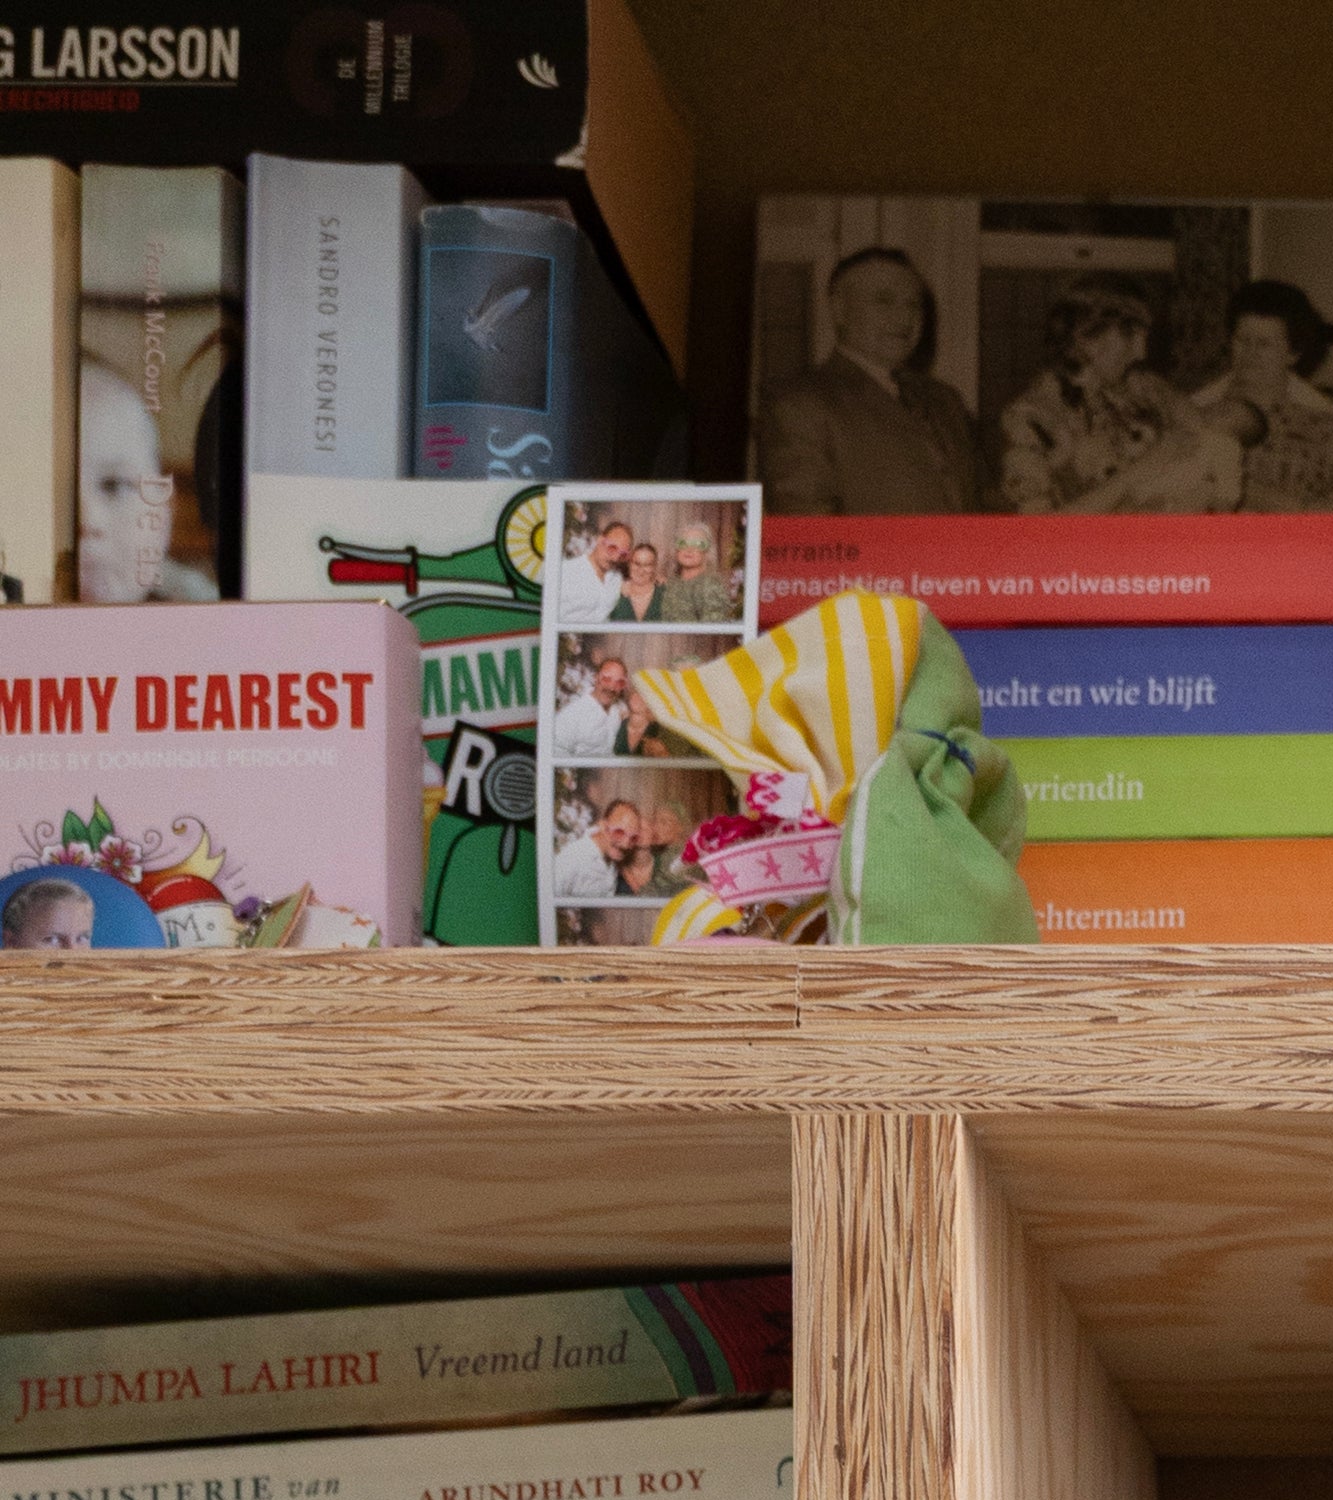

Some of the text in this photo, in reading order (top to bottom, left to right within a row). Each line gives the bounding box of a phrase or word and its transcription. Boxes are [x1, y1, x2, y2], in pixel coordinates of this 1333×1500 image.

[31, 25, 240, 80] LARSSON
[316, 215, 340, 454] SANDRO VERONESI
[911, 572, 1211, 596] leven van volwassenen
[135, 672, 374, 732] DEAREST
[1047, 679, 1216, 712] en wie blijft
[15, 1330, 629, 1421] JHUMPA LAHIRI Vreemd land
[637, 1468, 708, 1493] ROY
